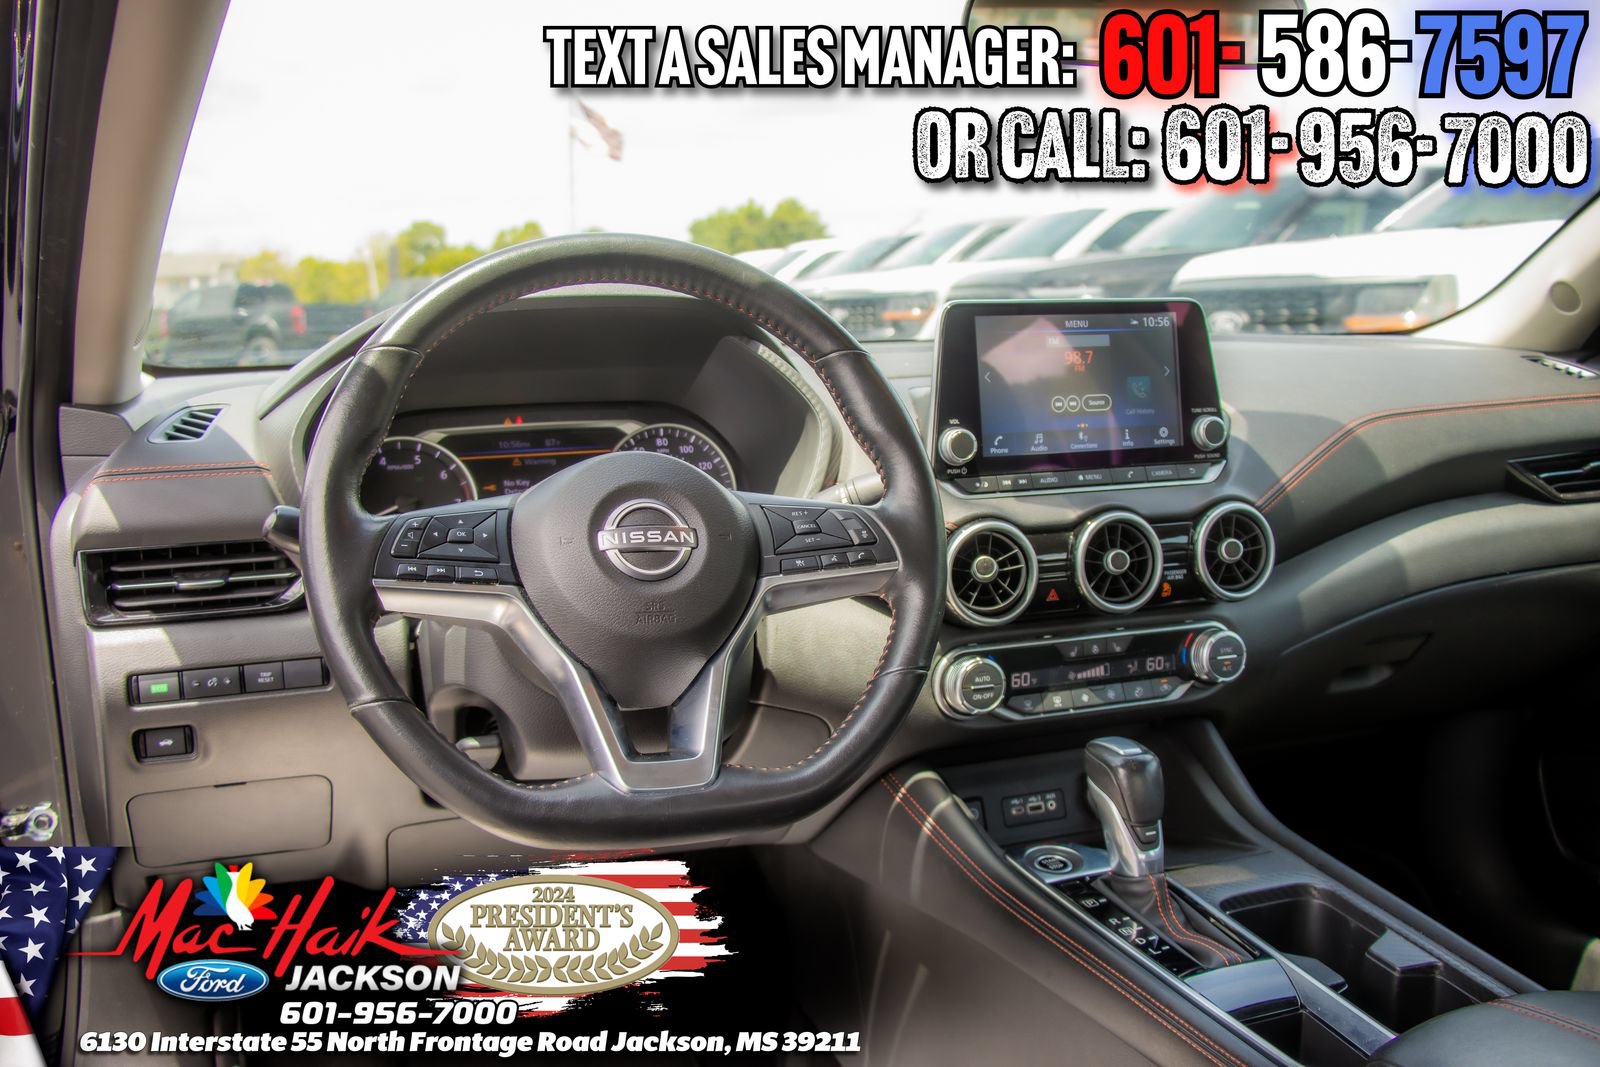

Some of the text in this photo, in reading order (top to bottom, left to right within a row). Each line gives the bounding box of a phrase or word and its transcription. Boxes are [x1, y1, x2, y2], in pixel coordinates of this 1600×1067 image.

[1065, 316, 1170, 328] MENU 10:56
[1064, 350, 1093, 365] 98.7
[656, 438, 669, 447] 80
[1153, 437, 1175, 446] Settings
[679, 444, 695, 454] 100
[1030, 444, 1048, 452] Audio
[379, 457, 387, 466] 4
[414, 455, 422, 465] 5
[440, 469, 448, 480] 6
[602, 530, 695, 545] NISSAN
[1135, 937, 1147, 945] D
